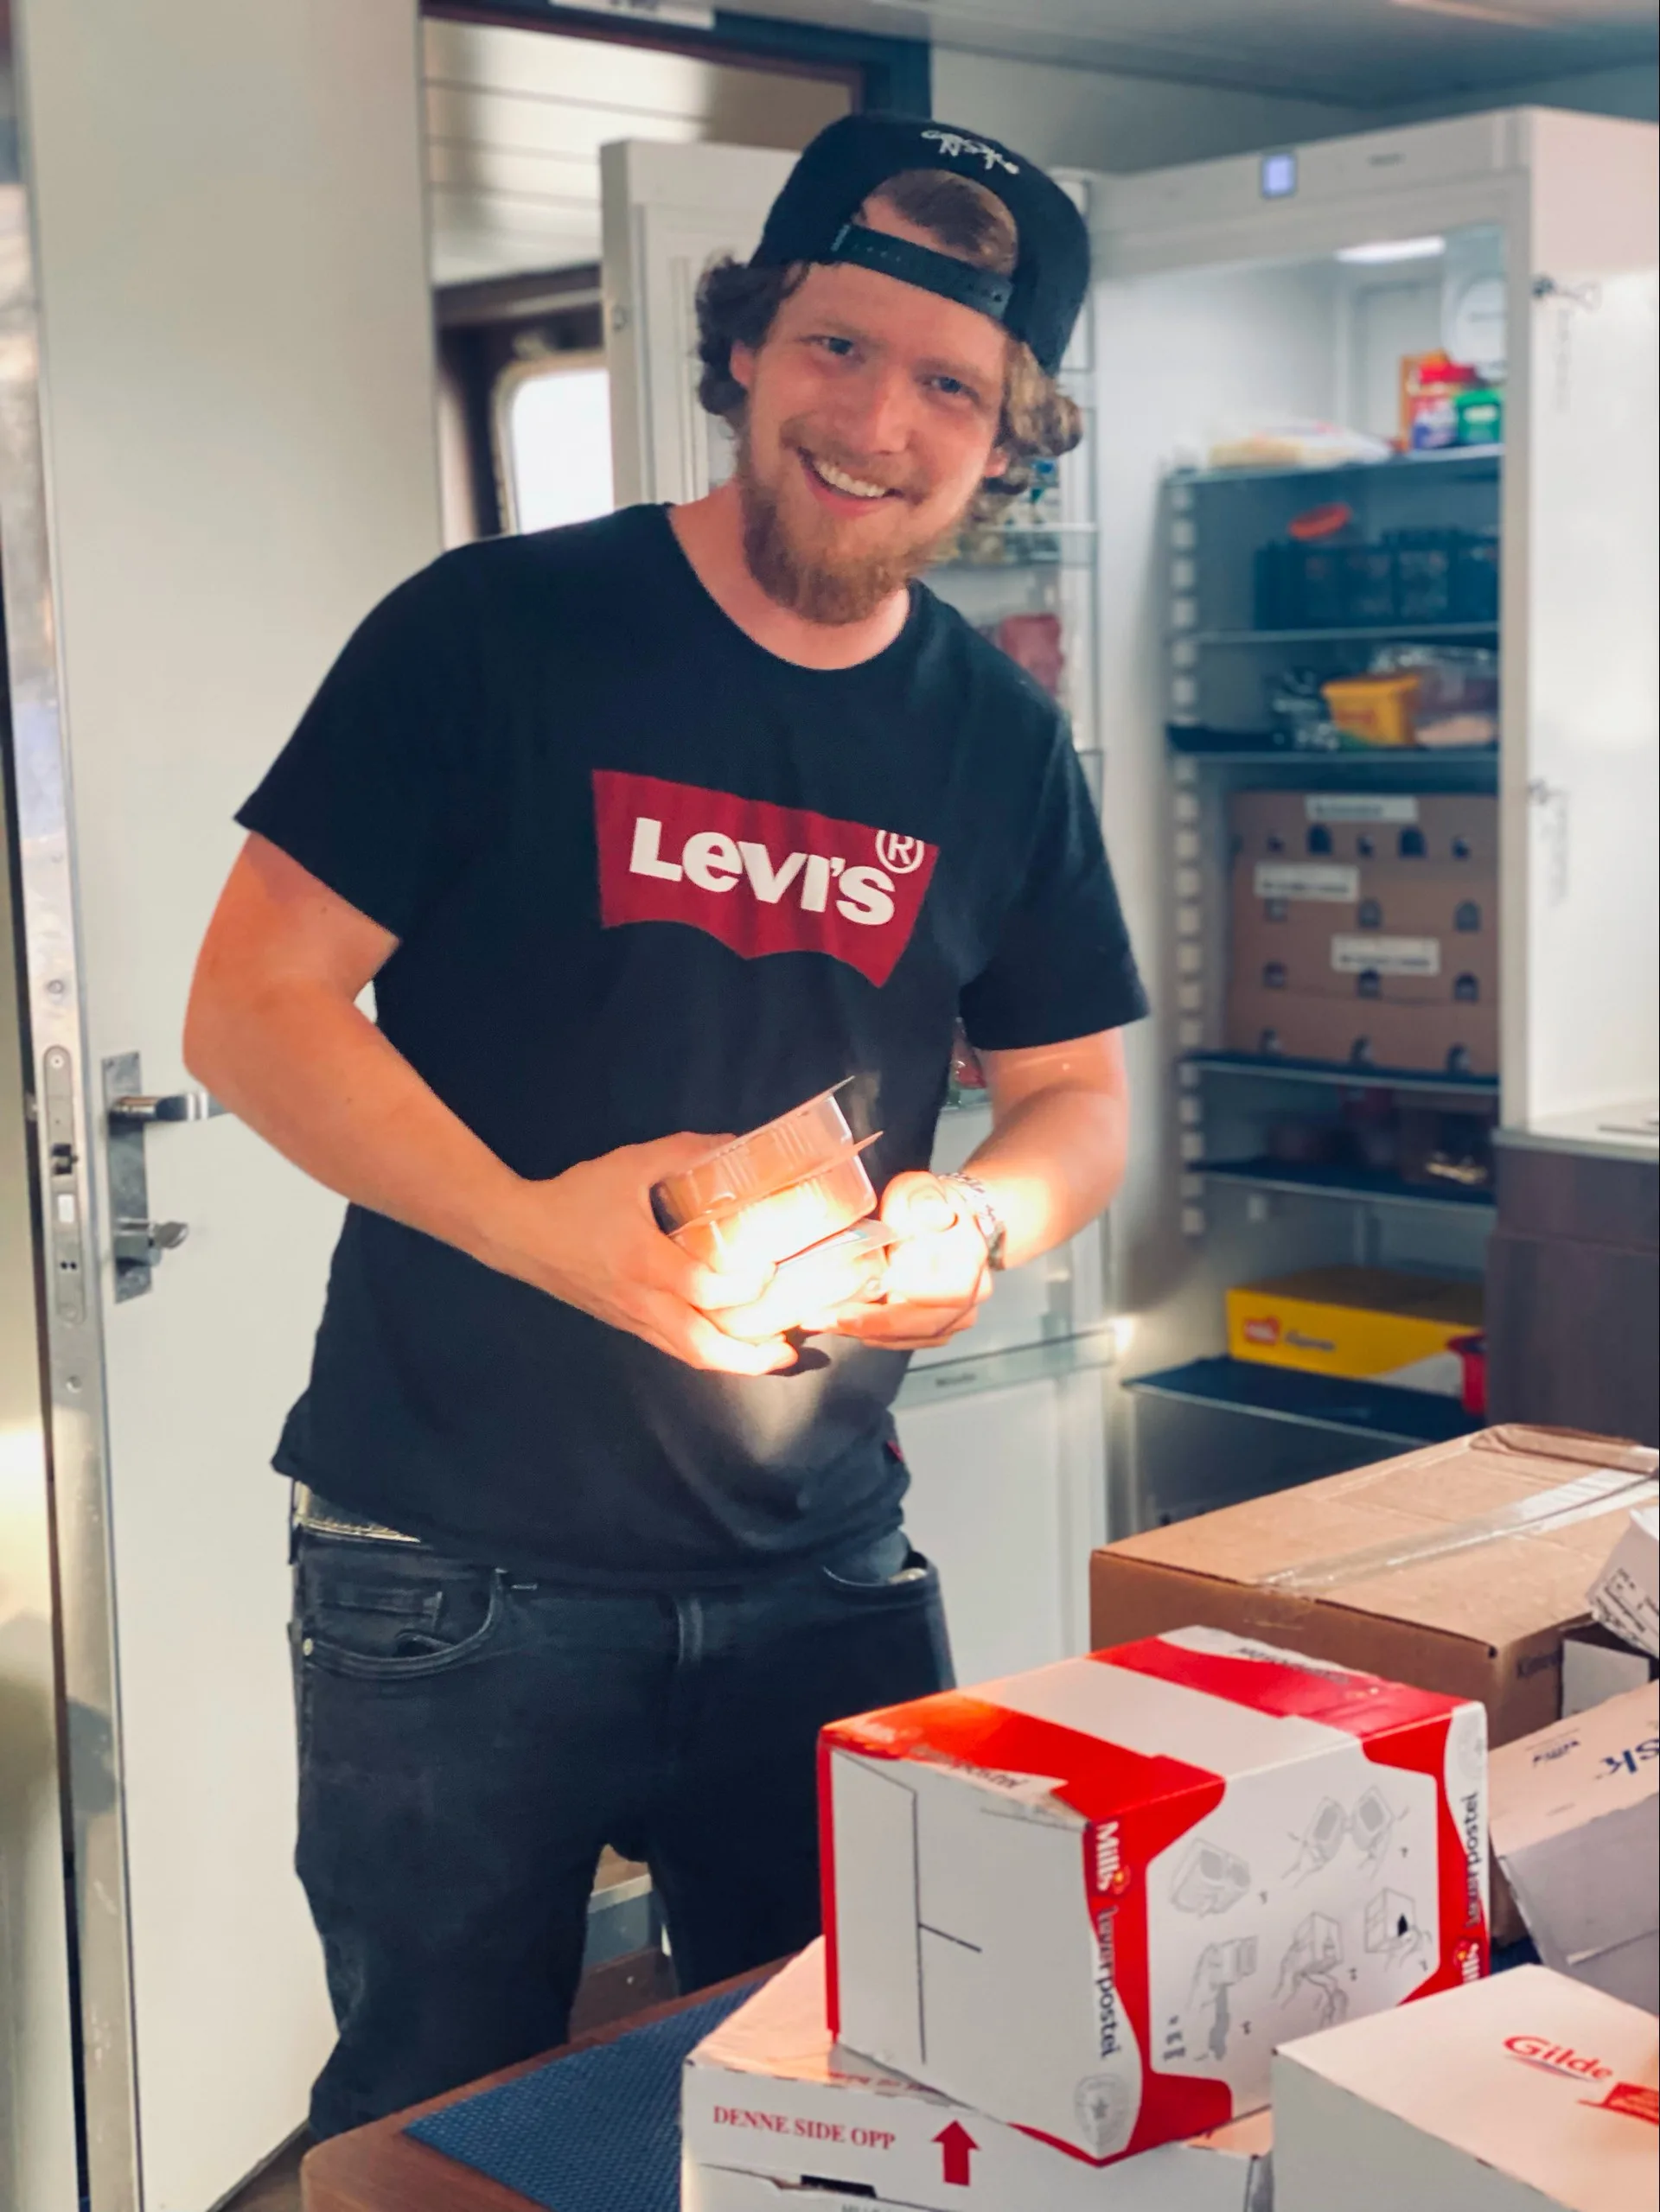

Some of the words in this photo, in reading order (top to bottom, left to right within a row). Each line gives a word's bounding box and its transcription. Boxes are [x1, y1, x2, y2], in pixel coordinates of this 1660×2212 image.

[629, 817, 895, 926] Levi's
[1095, 1820, 1120, 1891] Mills
[1461, 1942, 1479, 1983] ills
[1504, 2035, 1613, 2079] Gilde
[713, 2105, 789, 2134] DENNE
[794, 2118, 846, 2143] SIDE
[851, 2126, 896, 2150] OPP
